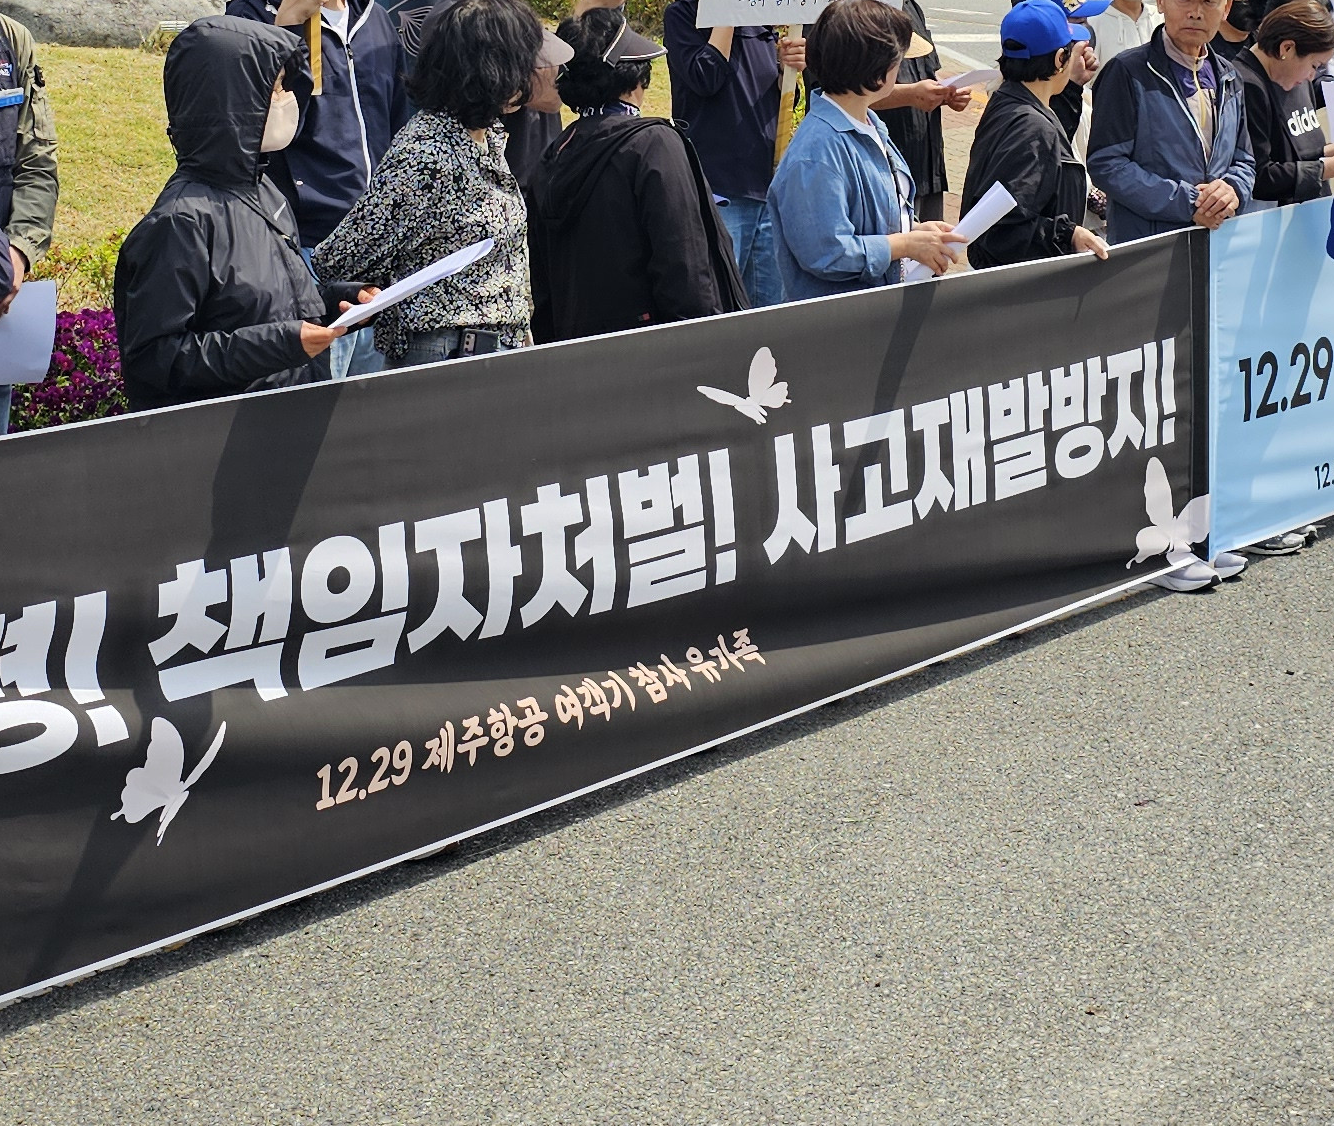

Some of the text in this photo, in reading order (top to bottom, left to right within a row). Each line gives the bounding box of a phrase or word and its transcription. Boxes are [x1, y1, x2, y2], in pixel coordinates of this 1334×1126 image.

[1238, 336, 1334, 423] 12.29
[147, 446, 737, 703] 책임자처벌!
[761, 337, 1177, 568] 사고재발방지!
[315, 628, 767, 811] 12.29 제주항공 여객기 참사 유가족
